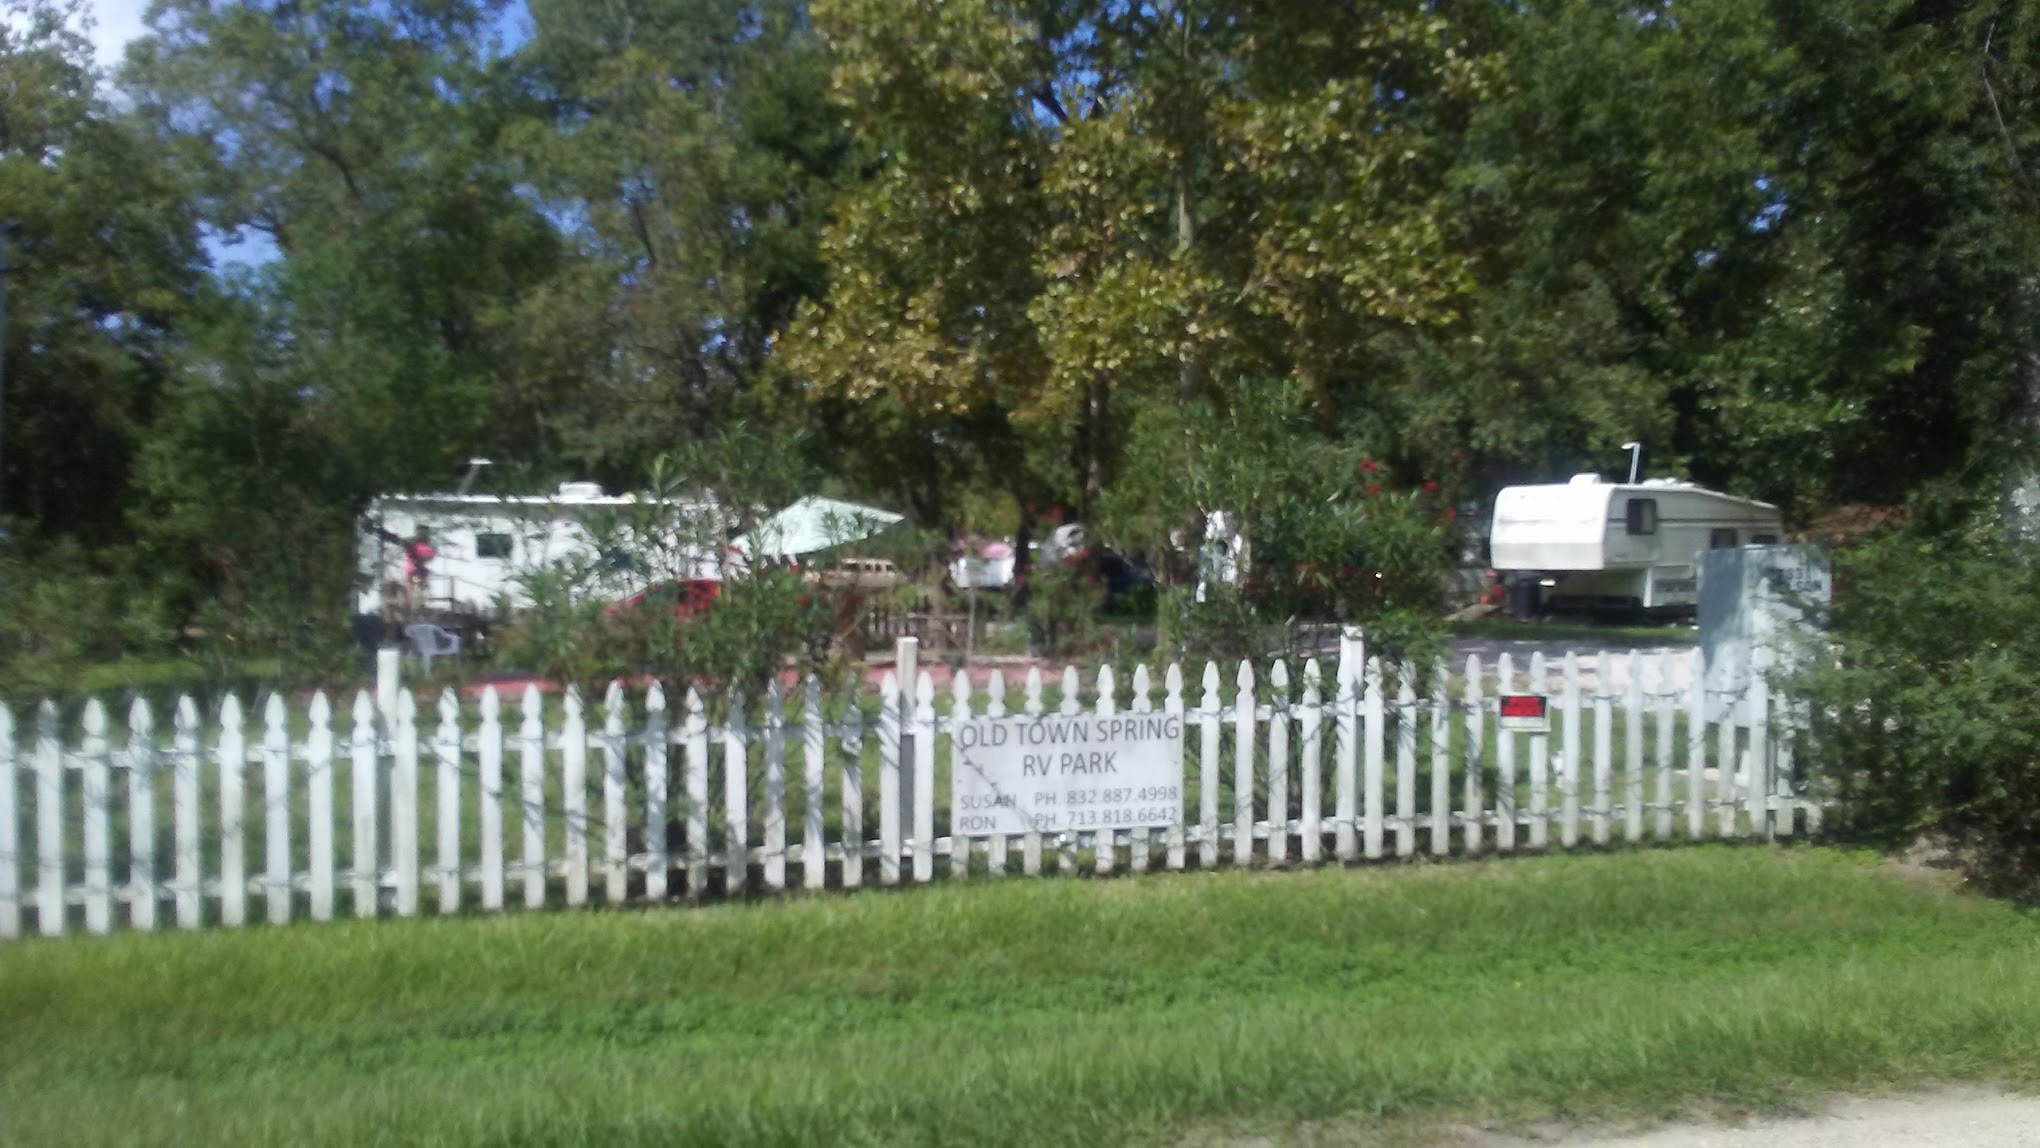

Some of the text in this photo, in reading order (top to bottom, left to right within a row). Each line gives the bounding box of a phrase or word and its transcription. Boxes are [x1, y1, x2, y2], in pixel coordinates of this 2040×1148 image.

[960, 716, 1180, 747] OLD TOWN SPRING
[1023, 751, 1118, 776] RV PARK
[960, 794, 1017, 810] SUSAN
[960, 816, 997, 830] RON
